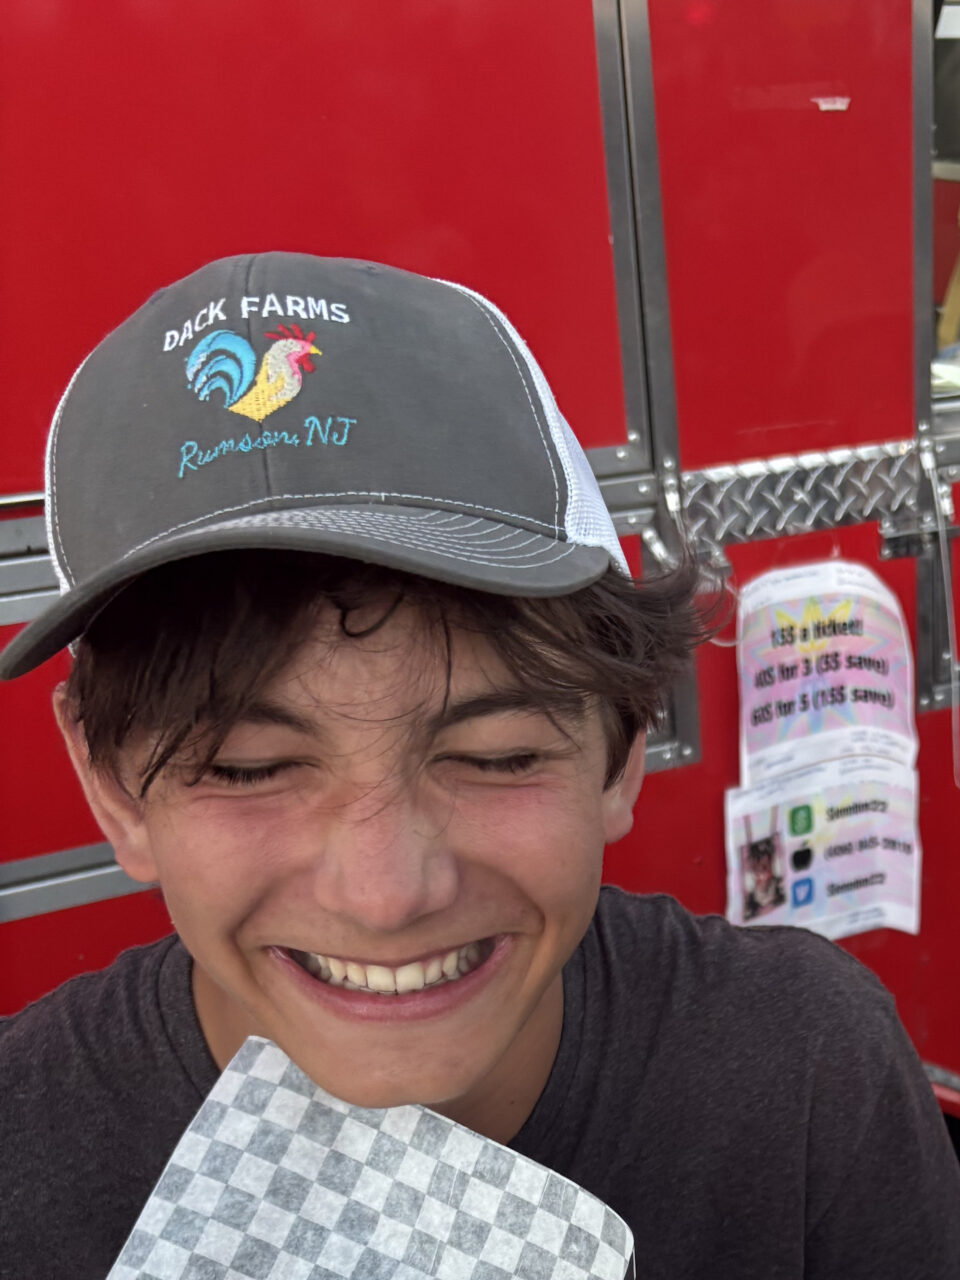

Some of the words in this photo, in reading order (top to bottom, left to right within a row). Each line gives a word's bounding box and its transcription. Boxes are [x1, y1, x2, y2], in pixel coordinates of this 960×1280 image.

[162, 298, 227, 352] DACK
[240, 293, 350, 324] FARMS
[303, 415, 358, 447] NJ
[778, 661, 799, 682] for
[802, 657, 812, 676] 3
[845, 652, 890, 676] save)
[775, 699, 796, 720] for
[850, 686, 896, 709] save)
